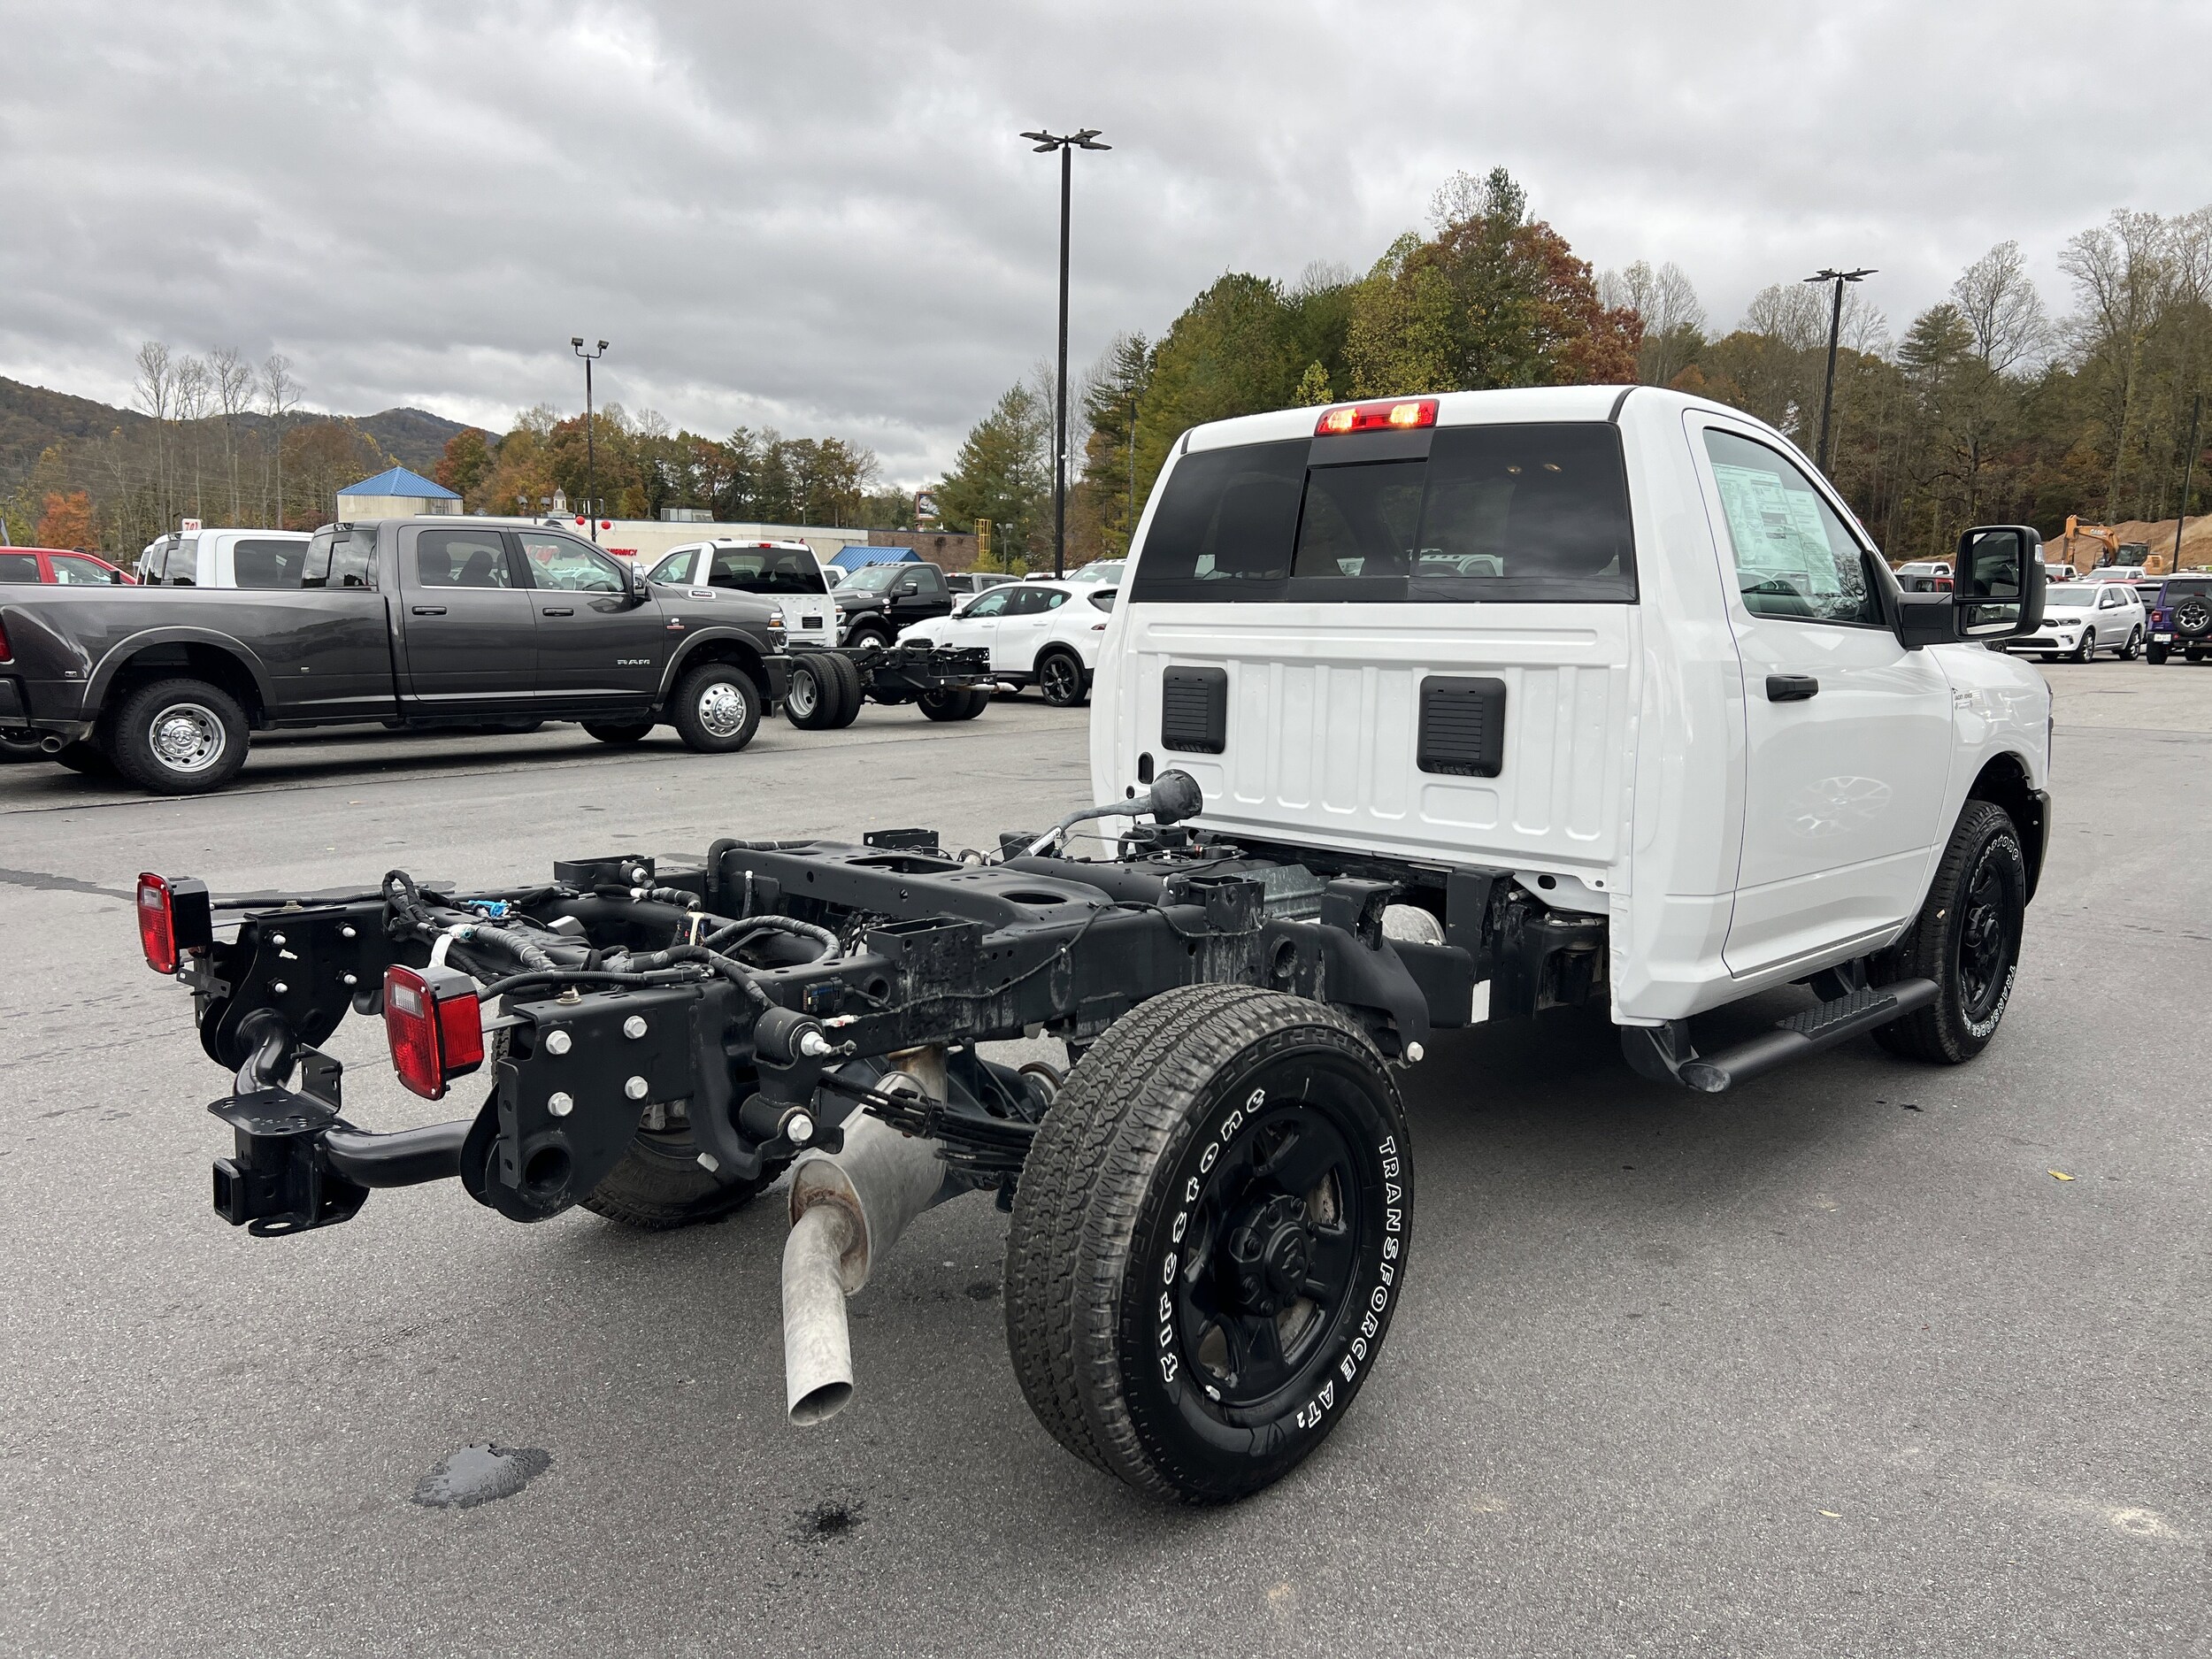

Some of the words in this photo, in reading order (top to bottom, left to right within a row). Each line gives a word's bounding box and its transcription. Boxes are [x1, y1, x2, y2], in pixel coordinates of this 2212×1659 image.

[1971, 965, 2016, 1038] TRANSFORCE
[1160, 1087, 1266, 1383] Firestone
[1340, 1135, 1402, 1383] TRANSFORCE
